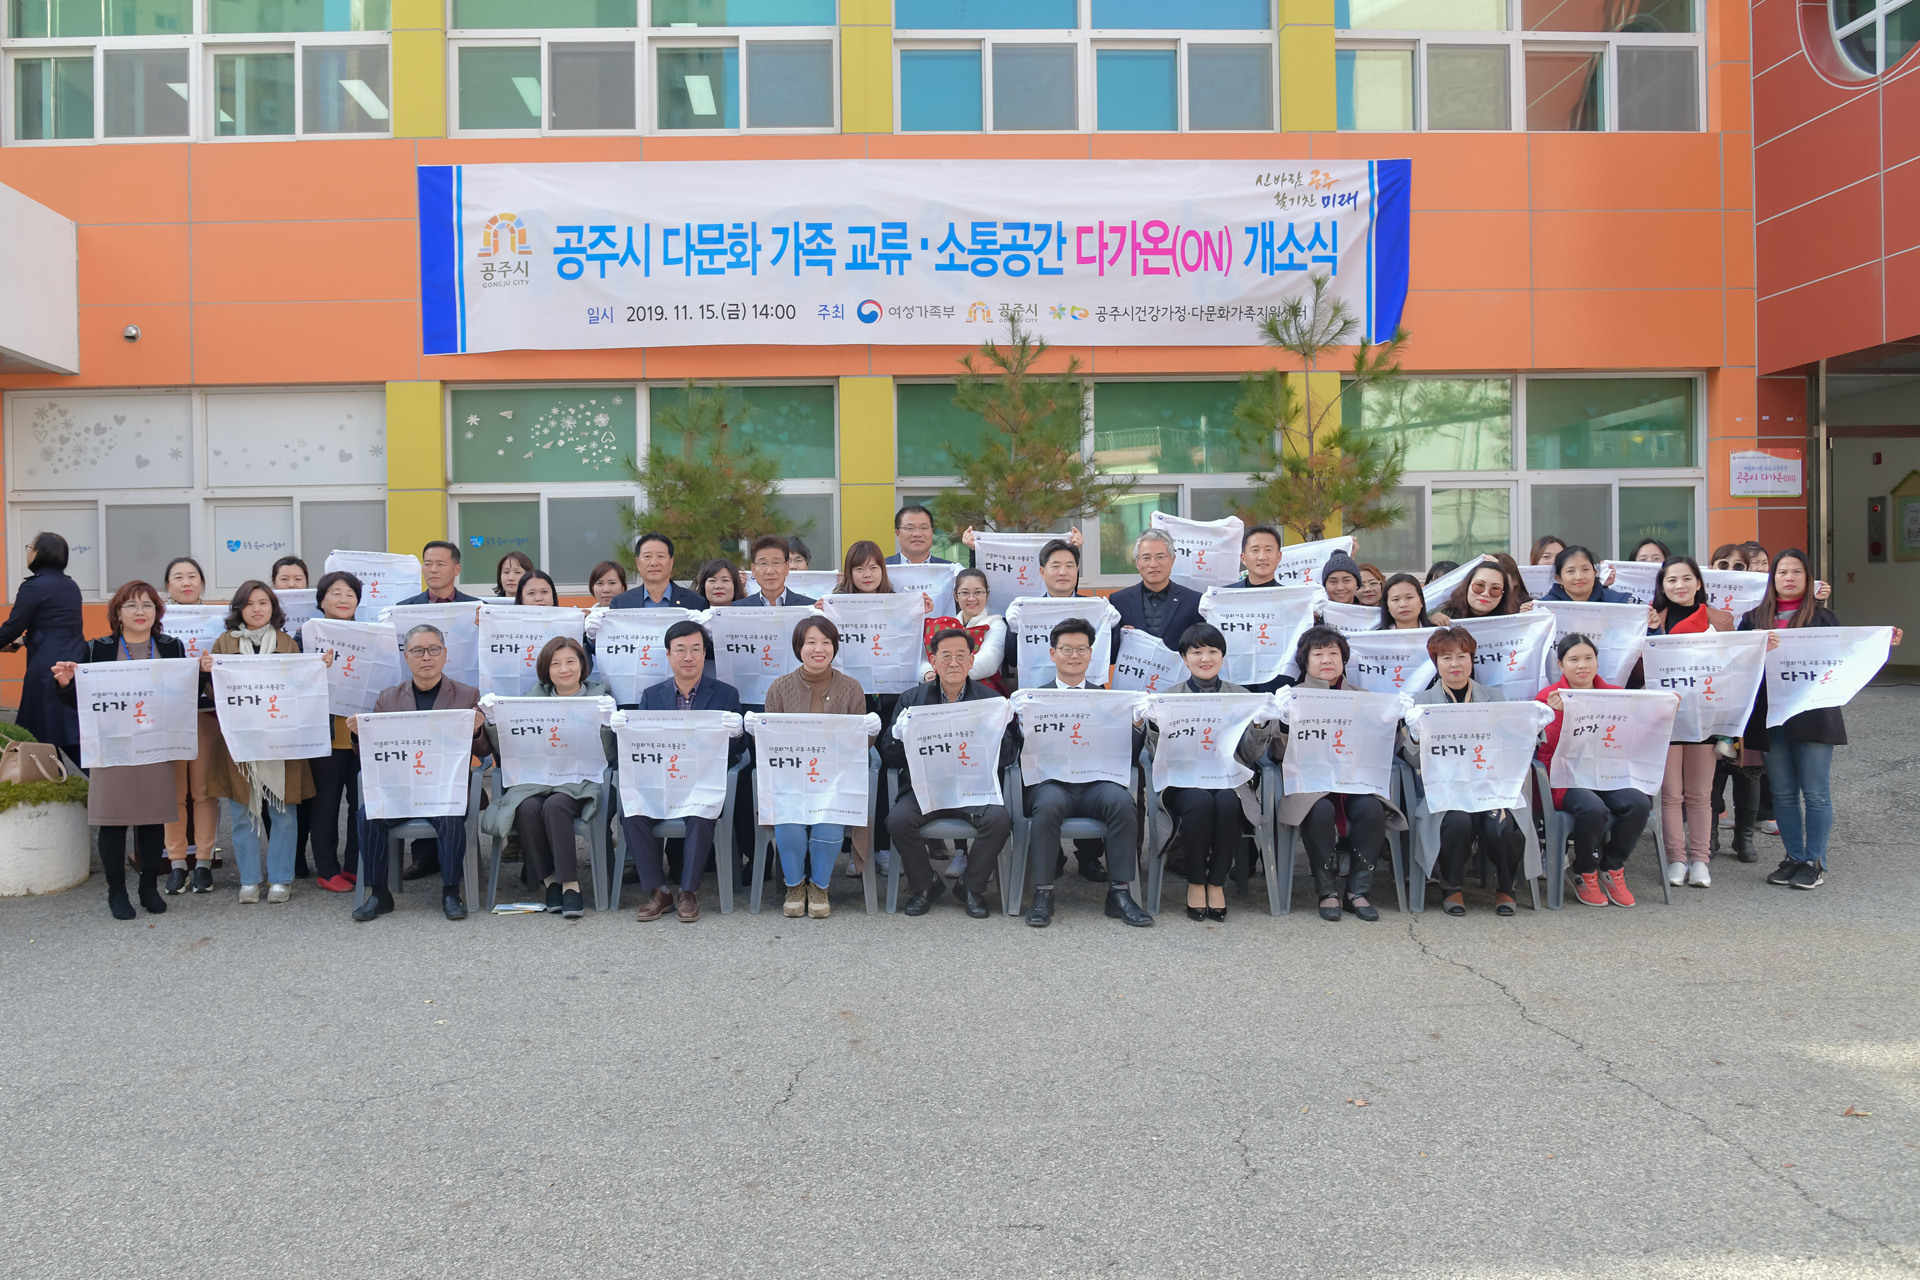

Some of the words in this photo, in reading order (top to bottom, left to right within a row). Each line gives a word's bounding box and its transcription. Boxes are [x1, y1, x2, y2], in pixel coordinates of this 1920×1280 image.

[1256, 172, 1304, 189] 신바람
[1308, 169, 1340, 190] 공주
[1274, 192, 1317, 211] 활기찬
[1321, 190, 1359, 212] 미래
[553, 222, 651, 281] 공주시
[662, 222, 762, 278] 다문화
[770, 222, 837, 277] 가족
[1075, 219, 1233, 278] 다가온(ON)
[1243, 220, 1338, 277] 개소식
[479, 262, 530, 281] 공주시
[482, 281, 512, 289] GONGJU
[514, 280, 530, 288] CITY
[586, 307, 615, 325] 일시
[626, 305, 669, 323] 2019.
[672, 305, 694, 322] 11.
[751, 303, 797, 321] 14:00
[817, 303, 846, 321] 주최
[888, 304, 956, 320] 여성가족부
[1736, 472, 1758, 483] 공주시
